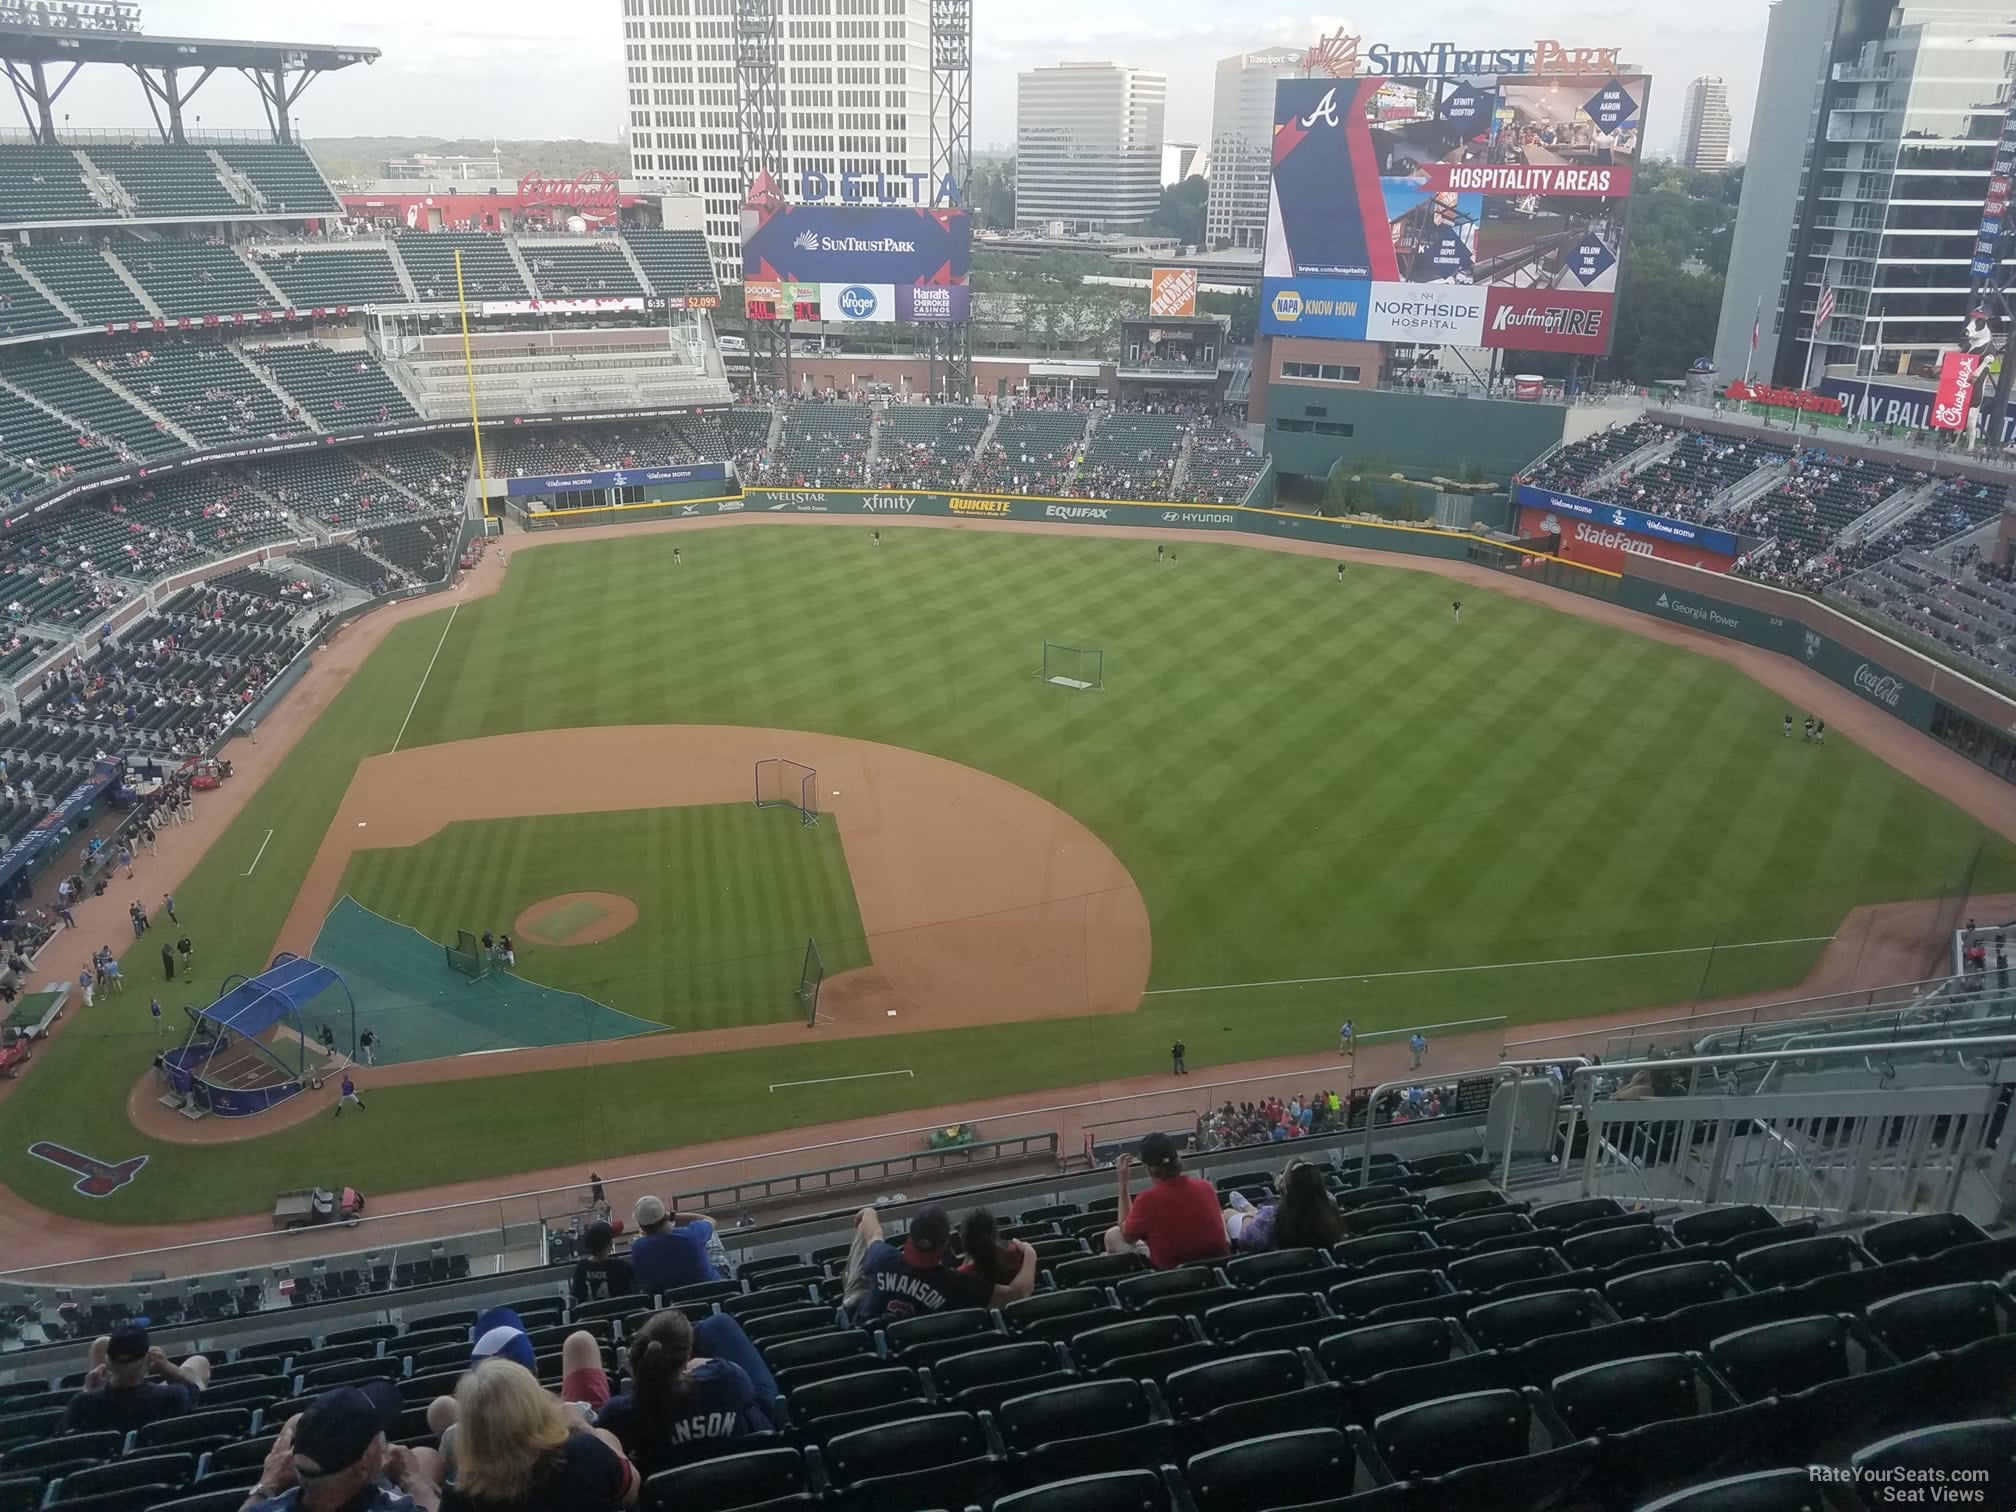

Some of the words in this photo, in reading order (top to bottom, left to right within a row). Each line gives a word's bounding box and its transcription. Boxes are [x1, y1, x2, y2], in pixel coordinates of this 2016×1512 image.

[1249, 55, 1285, 65] Travelport
[1603, 91, 1620, 99] HANK
[1600, 102, 1620, 110] AARON
[1449, 168, 1552, 190] HOSPITALITY
[1554, 170, 1611, 191] AREAS
[801, 170, 963, 207] DELTA
[1982, 222, 1998, 234] 1969
[1580, 246, 1600, 254] BELOW
[1978, 242, 1993, 254] 1991
[1298, 266, 1367, 275] braves.com/hospitality
[1974, 261, 1989, 273] 1993
[1156, 273, 1175, 292] THE
[914, 288, 950, 299] Harrah's
[1152, 270, 1195, 314] HOME
[647, 299, 666, 308] 6:35
[842, 290, 874, 315] Kroger
[1168, 285, 1194, 315] DEPOT
[1277, 299, 1298, 313] NAPA
[362, 303, 377, 315] 42
[1305, 300, 1333, 315] KNOW
[1335, 301, 1357, 316] HOW
[1375, 302, 1480, 319] NORTHSIDE
[1391, 318, 1458, 330] HOSPITAL
[1492, 306, 1561, 331] Kauffman
[1546, 307, 1602, 337] TIRE
[1838, 392, 1884, 422] PLAY
[1885, 400, 1930, 430] BALL
[767, 492, 825, 503] WELLSTAR
[862, 494, 916, 512] xfinity
[949, 498, 1011, 511] QUIKRETE
[1046, 505, 1108, 519] EQUIFAX
[1182, 513, 1233, 523] HYUNDAI
[1646, 519, 1673, 533] Welcome
[1671, 600, 1707, 619] Georgia
[1709, 610, 1739, 629] Power
[877, 1272, 947, 1311] SWANSON
